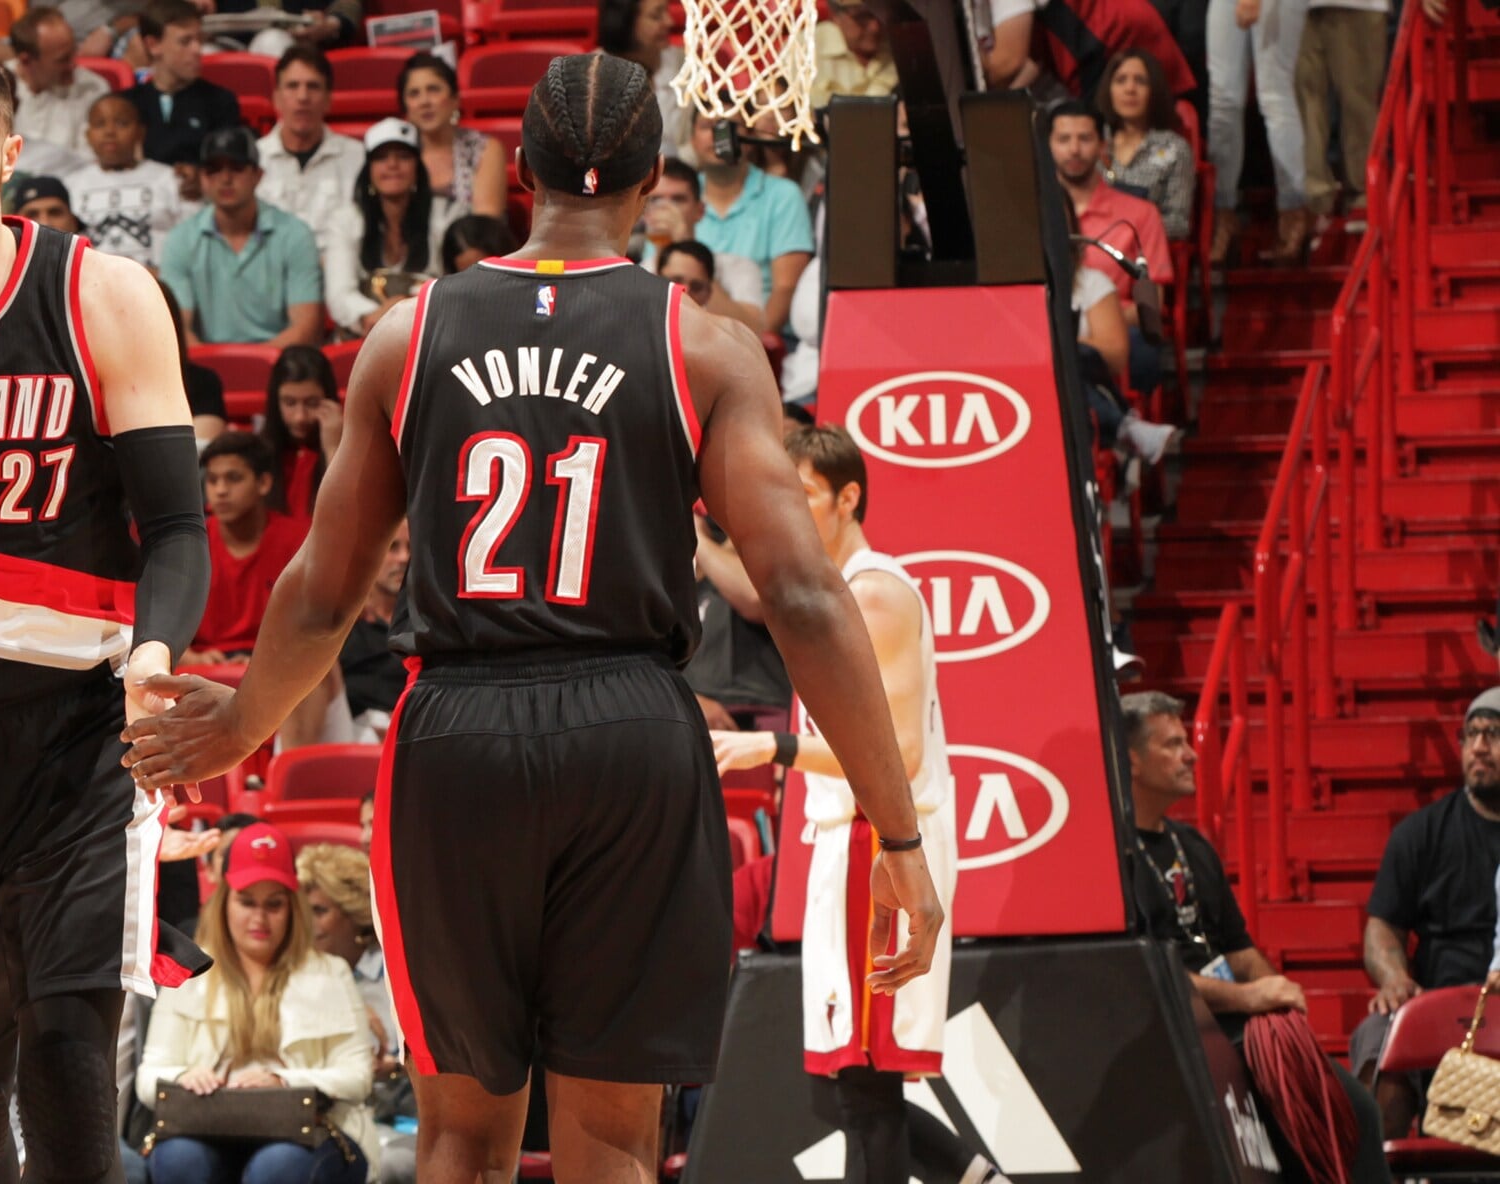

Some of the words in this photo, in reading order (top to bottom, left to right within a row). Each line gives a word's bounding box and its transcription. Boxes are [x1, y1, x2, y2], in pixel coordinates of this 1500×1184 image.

[451, 346, 626, 415] VONLEH
[877, 393, 1000, 447] KIA
[456, 430, 607, 606] 21
[910, 575, 1015, 636] IA
